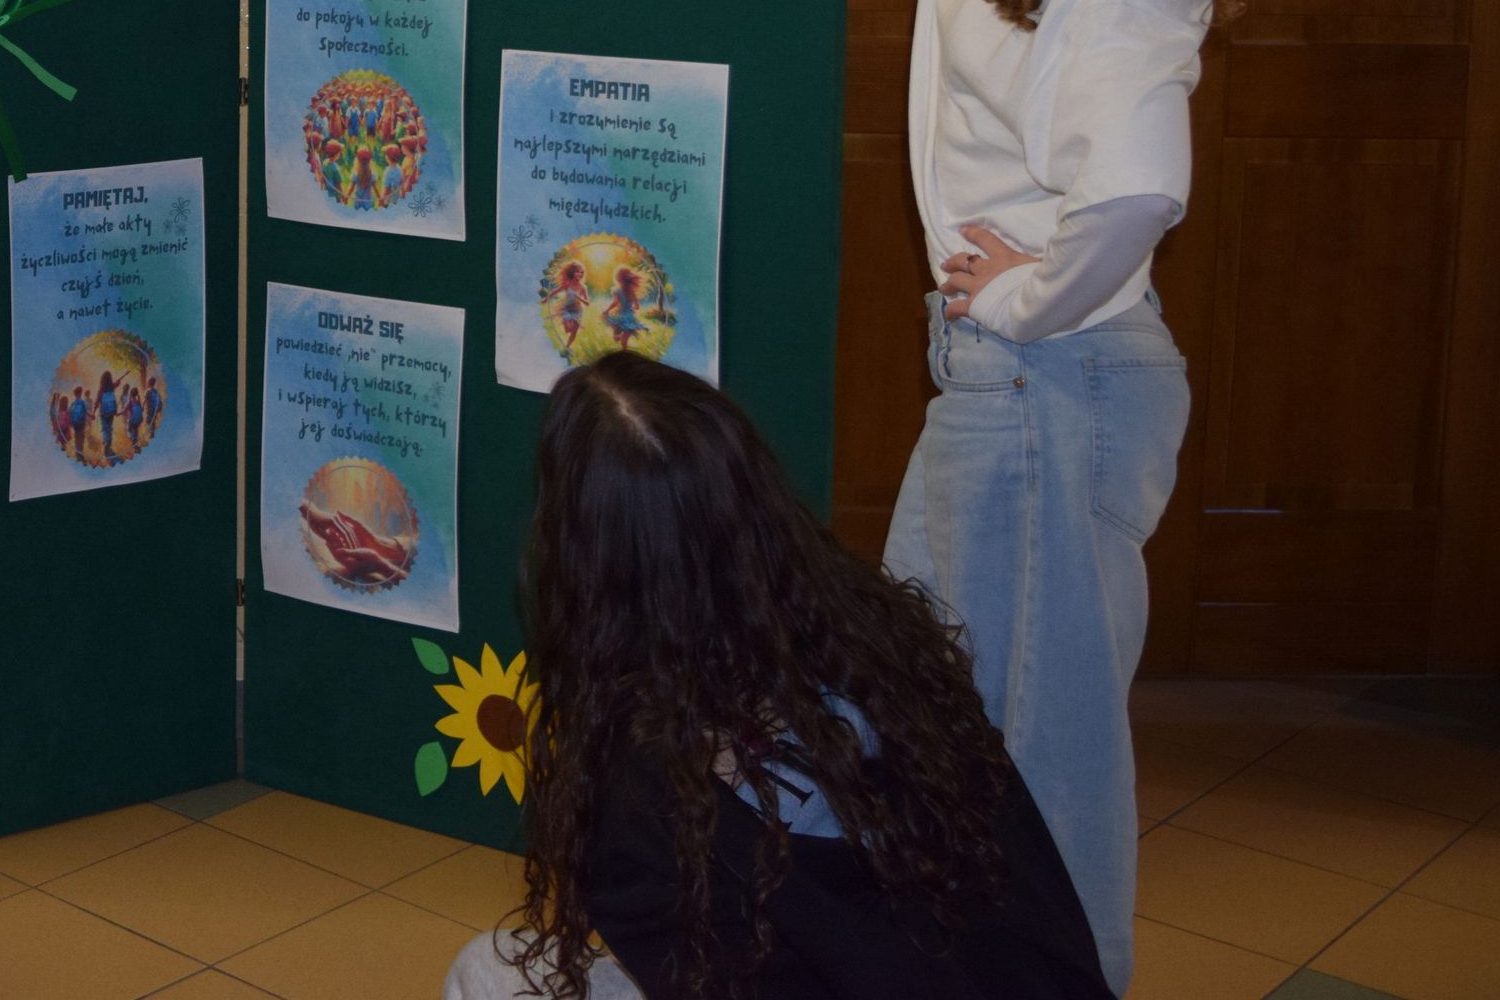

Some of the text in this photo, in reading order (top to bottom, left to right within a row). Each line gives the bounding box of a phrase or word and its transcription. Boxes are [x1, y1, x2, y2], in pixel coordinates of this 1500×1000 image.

[296, 7, 433, 39] do pokoju każdej
[569, 79, 649, 102] EMPATIA
[559, 112, 651, 132] zrozumienie
[513, 135, 705, 168] najlepszymi narzędziami
[530, 165, 687, 202] do budowania relacji
[64, 214, 151, 237] że małe akty
[548, 198, 665, 224] międzyludzkich.
[20, 237, 188, 277] życzliwości mogą zmienić
[60, 270, 144, 298] czyjś dzień,
[69, 297, 153, 320] nawet życie.
[318, 312, 404, 344] ODWAŻ SIĘ
[275, 337, 341, 357] powiedzieć
[380, 354, 451, 382] przemocy,
[303, 363, 416, 399] kiedy widzisz,
[286, 392, 446, 438] wspieraj tych, którzy
[298, 419, 424, 458] jej doświadczają.
